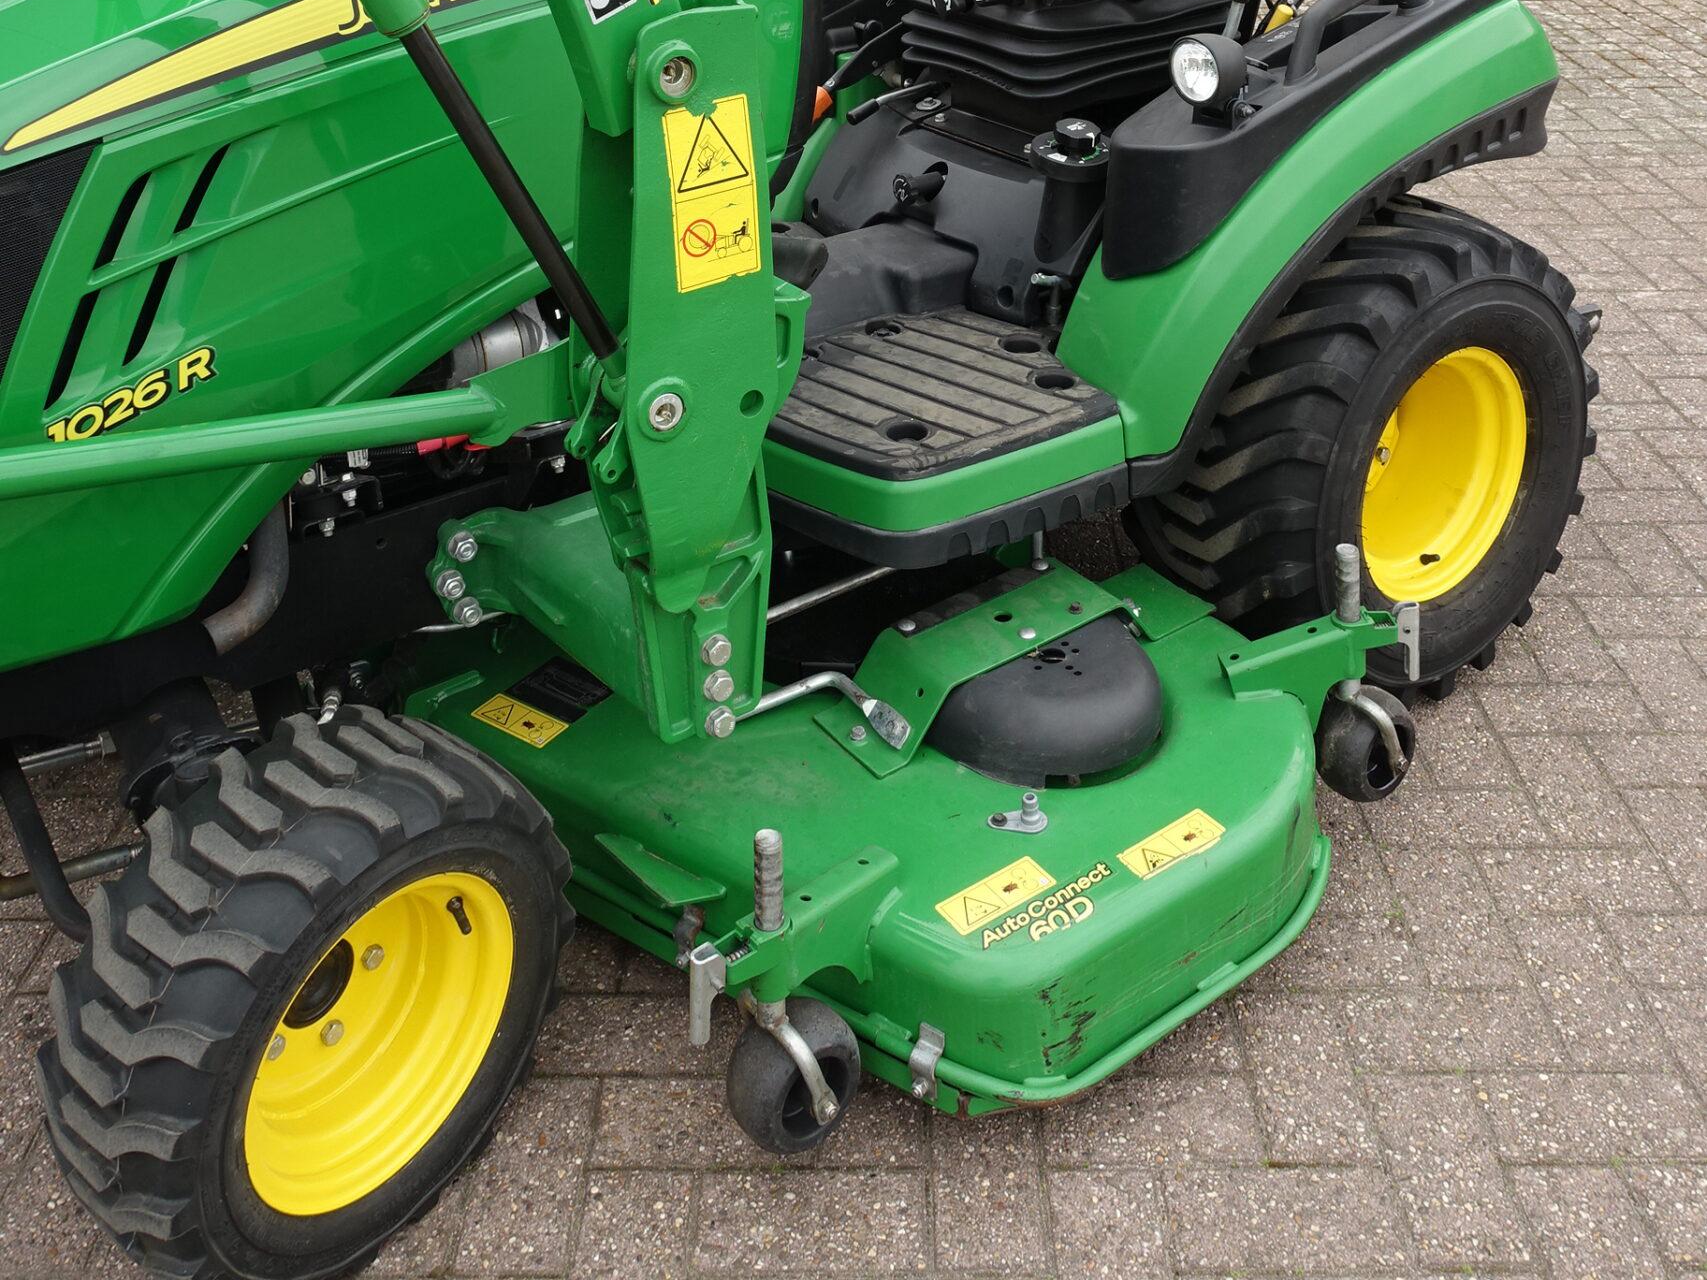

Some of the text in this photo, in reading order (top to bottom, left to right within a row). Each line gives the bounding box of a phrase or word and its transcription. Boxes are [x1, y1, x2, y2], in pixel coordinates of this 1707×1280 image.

[47, 347, 217, 443] 1026 R
[982, 861, 1113, 950] AutoConnect
[1028, 895, 1095, 942] 60D
